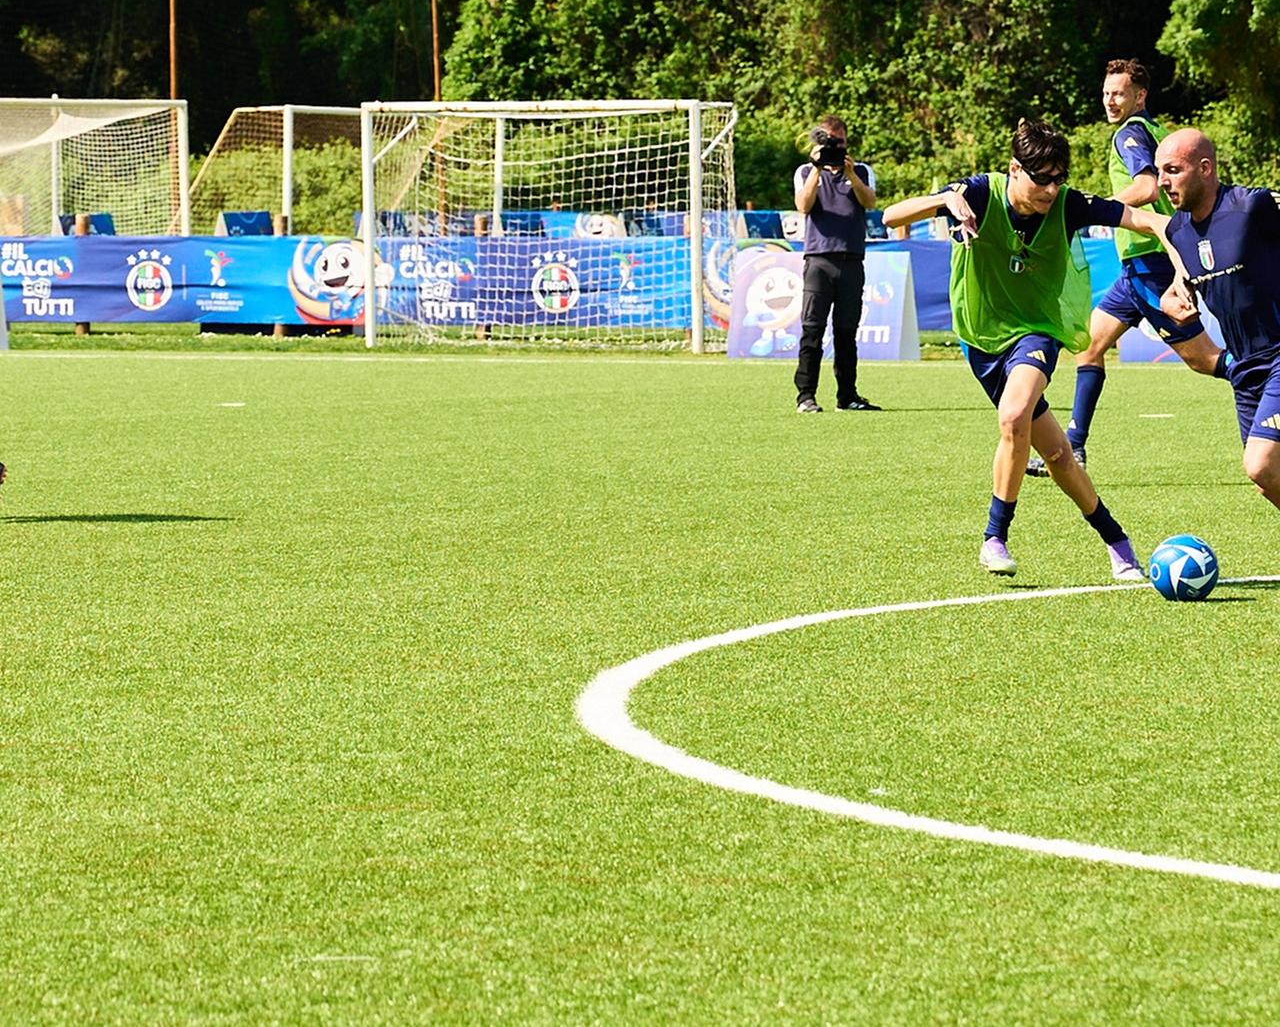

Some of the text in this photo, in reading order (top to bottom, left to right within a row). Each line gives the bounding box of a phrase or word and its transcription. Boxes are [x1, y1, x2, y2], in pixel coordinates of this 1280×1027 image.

[1, 242, 29, 260] #IL
[400, 244, 428, 261] #IL
[22, 298, 74, 316] TUTTI
[422, 301, 476, 319] TUTTI
